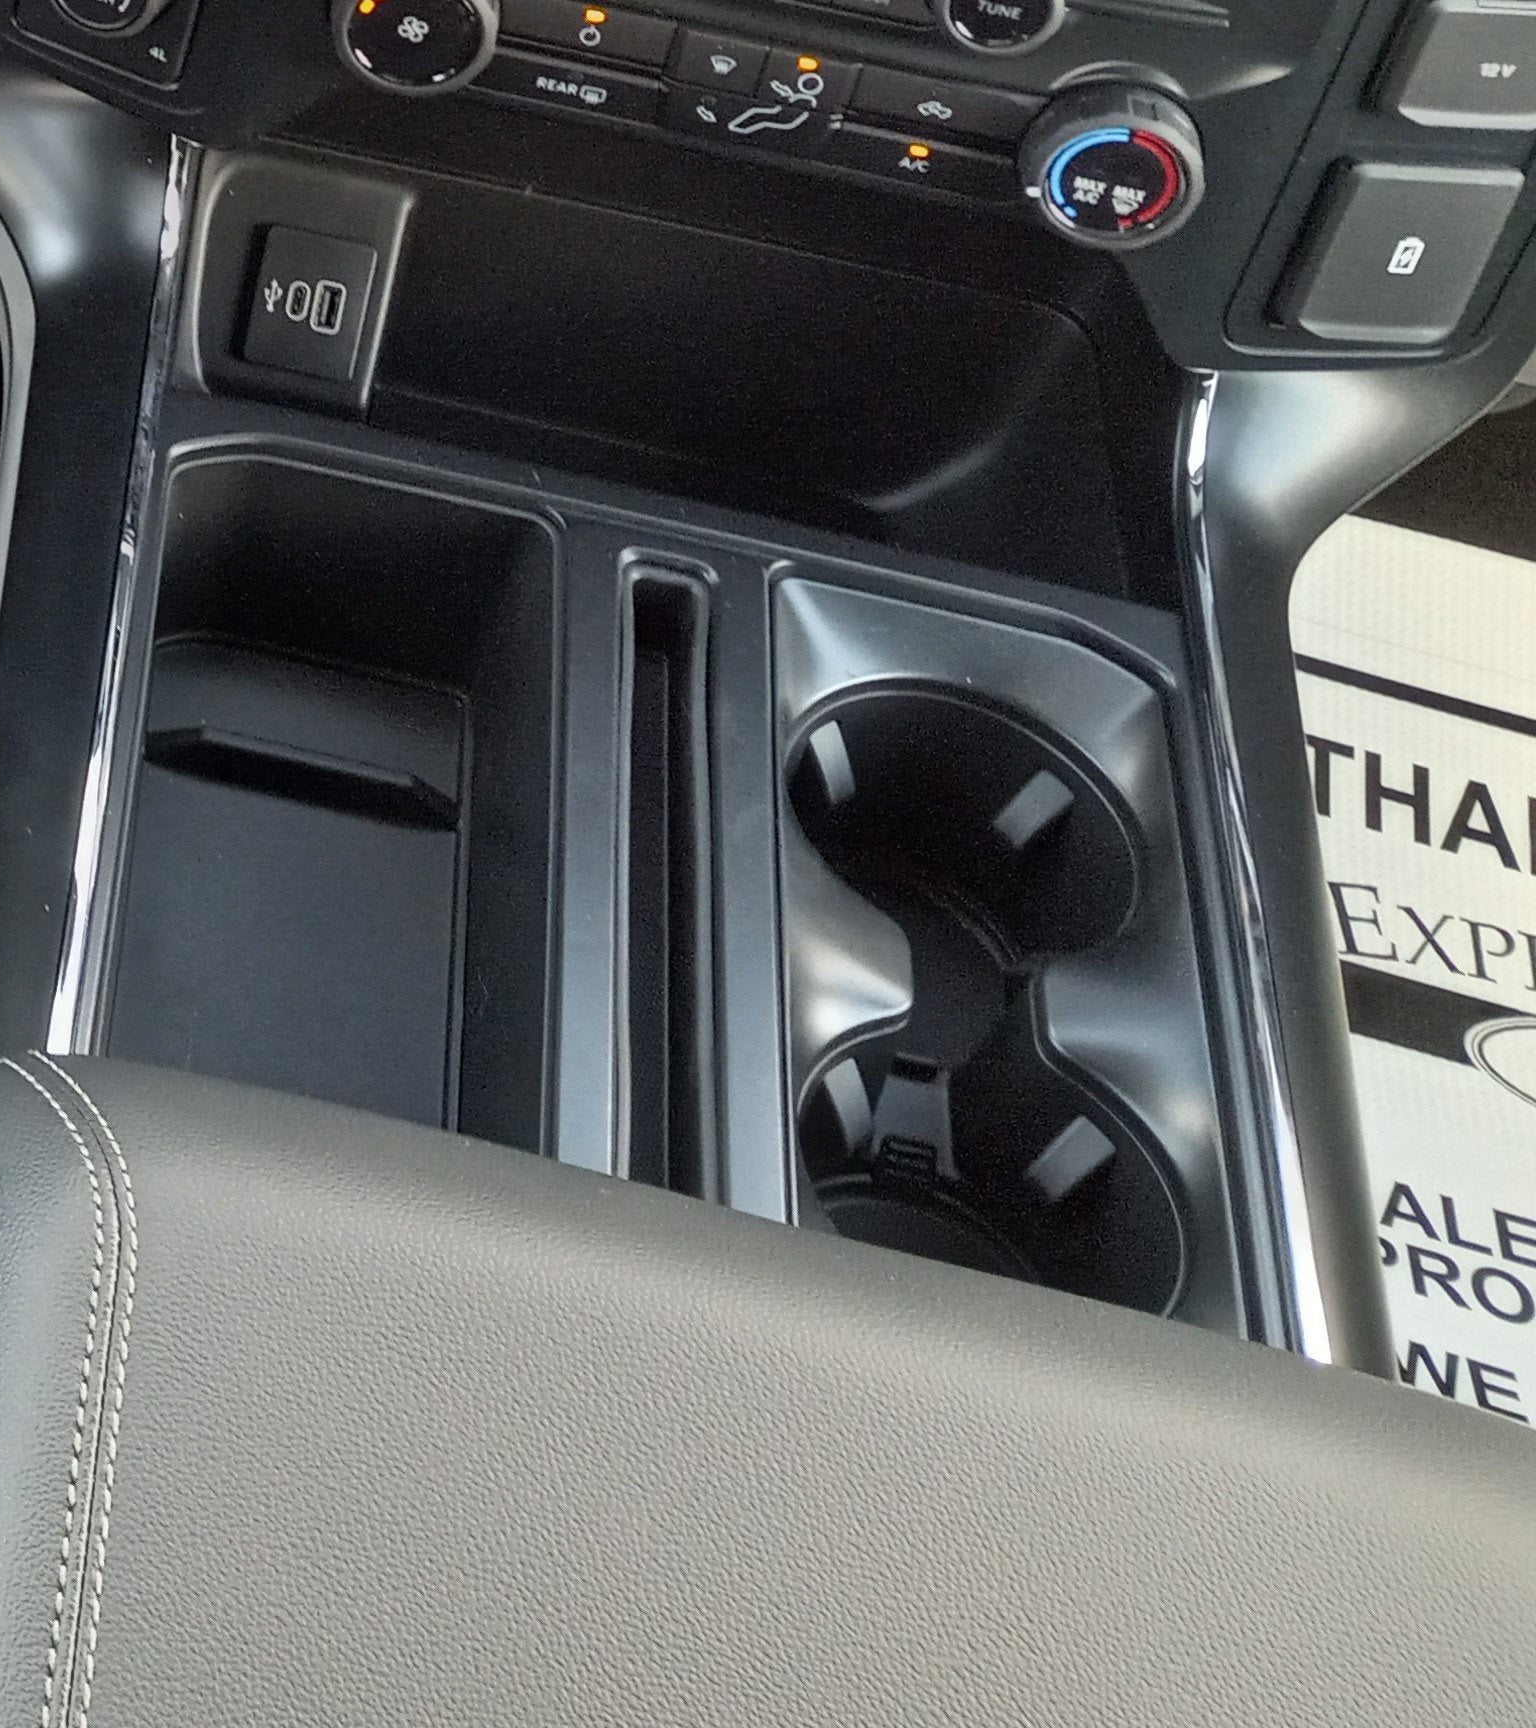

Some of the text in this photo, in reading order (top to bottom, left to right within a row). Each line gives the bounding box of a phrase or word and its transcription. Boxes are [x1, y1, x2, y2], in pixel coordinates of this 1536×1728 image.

[536, 75, 579, 96] REAR
[1305, 733, 1536, 877] THA
[1327, 880, 1536, 992] EXP
